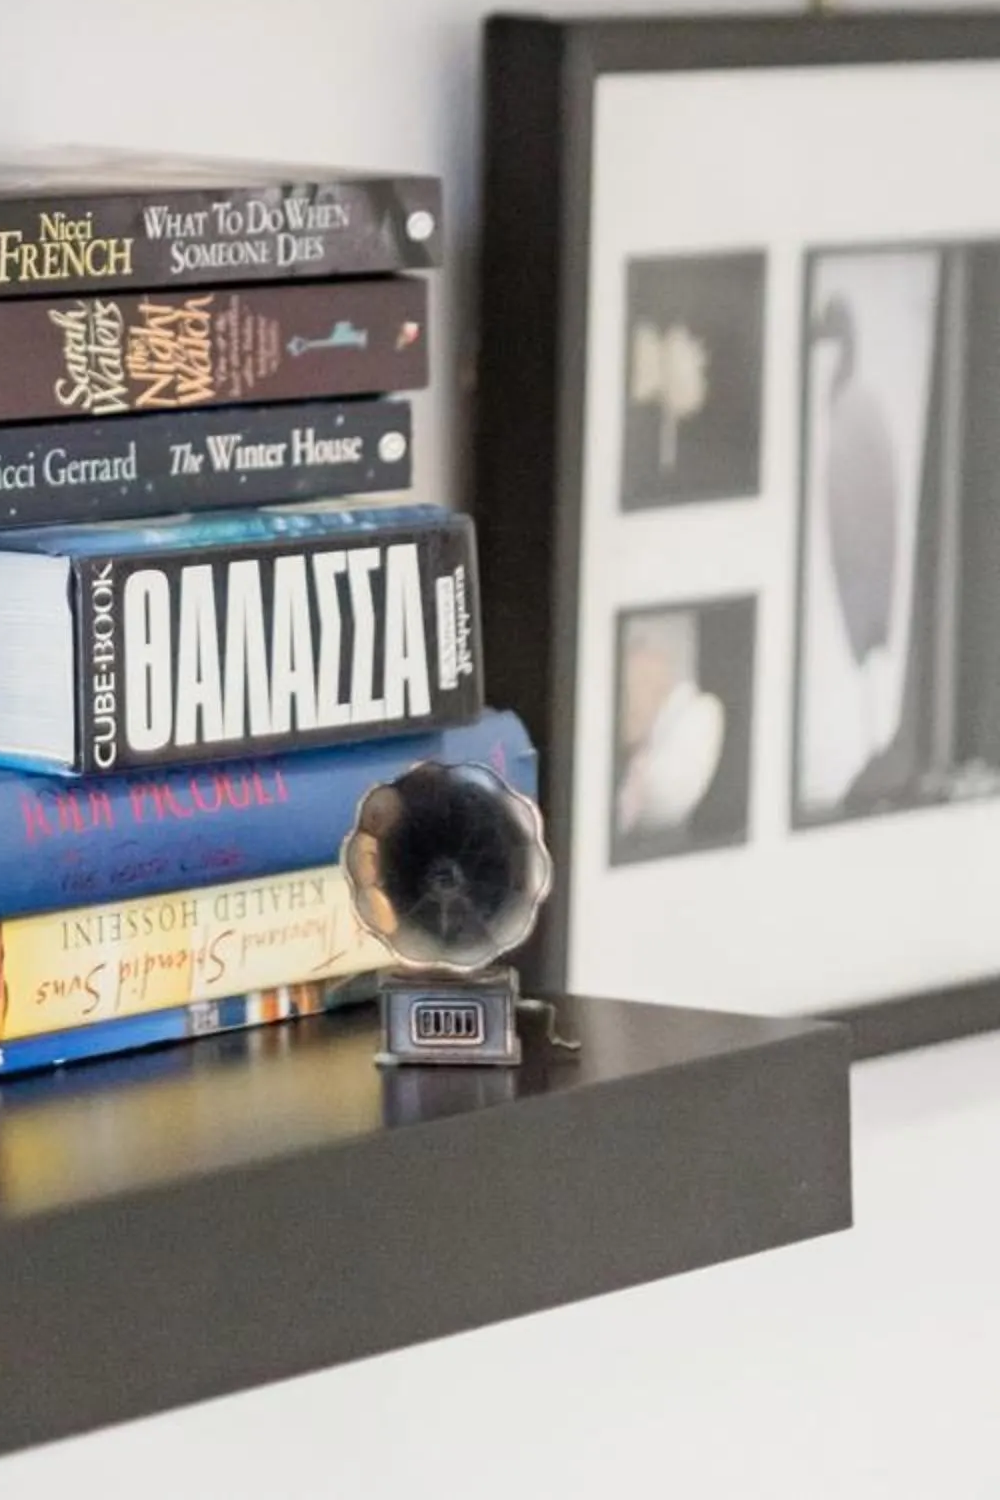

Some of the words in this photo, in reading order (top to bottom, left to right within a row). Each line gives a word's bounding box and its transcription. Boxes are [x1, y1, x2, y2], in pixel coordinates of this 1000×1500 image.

[39, 211, 93, 243] Nicci
[144, 205, 206, 240] WHAT
[283, 197, 350, 230] WHEN
[170, 239, 271, 273] SOMEONE
[276, 233, 325, 264] DIES
[48, 299, 91, 410] Sarah
[87, 299, 130, 417] Waters
[134, 297, 186, 408] Night
[174, 293, 215, 405] Watch
[44, 442, 136, 486] Gerrard
[169, 442, 205, 476] The
[207, 433, 286, 472] Winter
[291, 427, 364, 466] House
[216, 877, 326, 925] KHALED
[61, 901, 201, 952] HOSSEINI
[36, 964, 105, 1014] Suns
[114, 928, 234, 1008] Splendid
